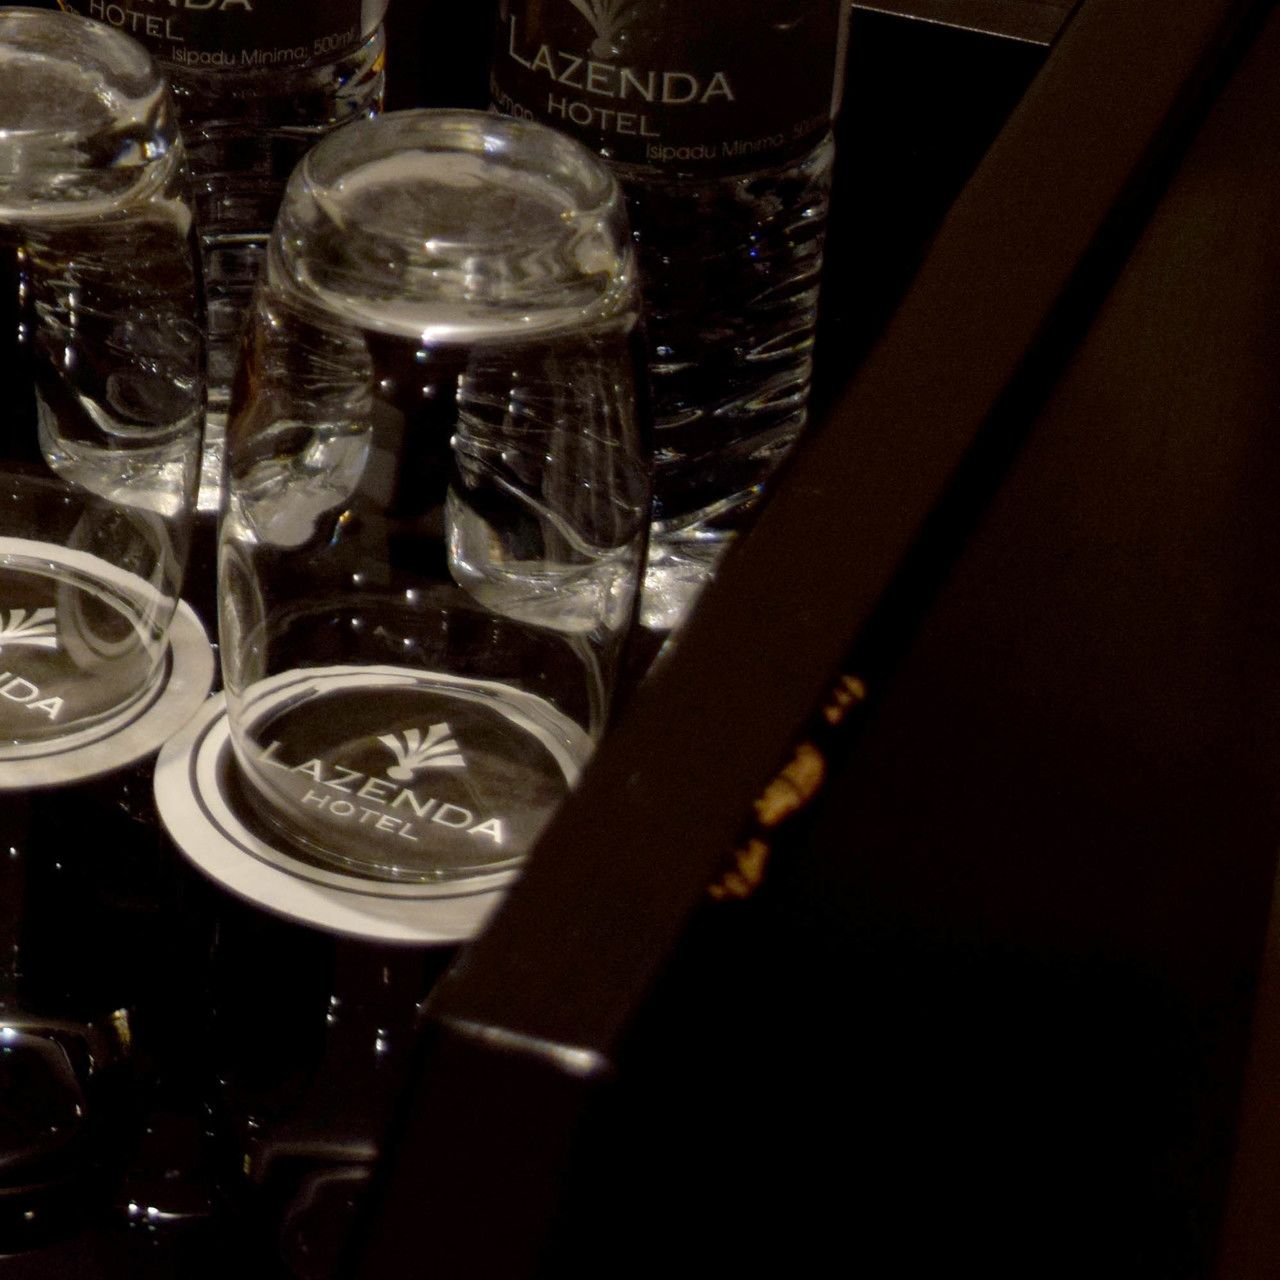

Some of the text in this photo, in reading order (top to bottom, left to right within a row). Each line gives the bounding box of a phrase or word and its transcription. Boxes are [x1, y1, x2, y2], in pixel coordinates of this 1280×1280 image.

[171, 46, 237, 69] Isipadu
[508, 14, 737, 105] LAZENDA
[546, 92, 661, 138] HOTEL
[645, 142, 718, 164] Isipadu
[257, 740, 505, 845] LAZENDA
[300, 789, 420, 842] HOTEL
